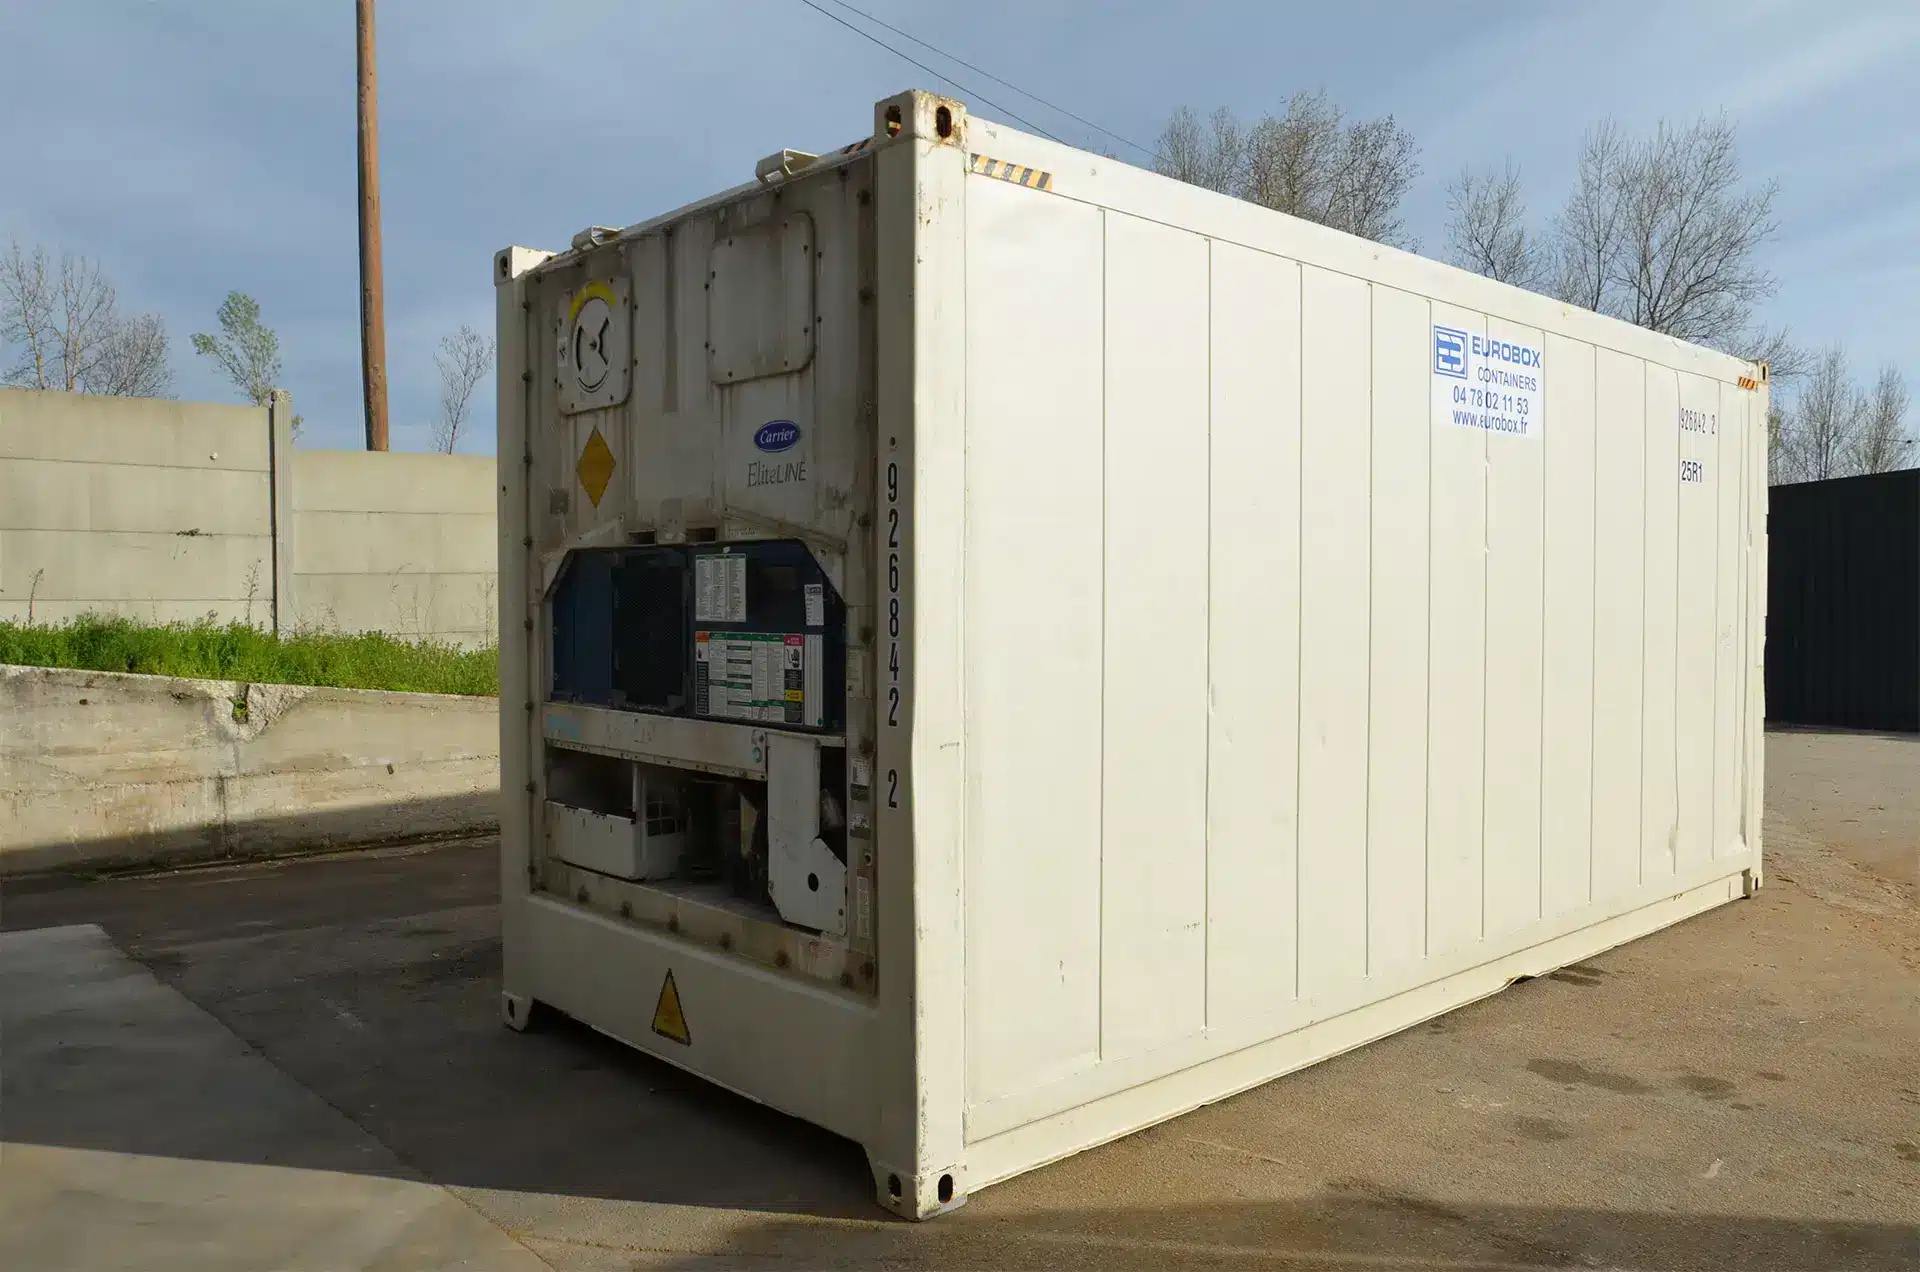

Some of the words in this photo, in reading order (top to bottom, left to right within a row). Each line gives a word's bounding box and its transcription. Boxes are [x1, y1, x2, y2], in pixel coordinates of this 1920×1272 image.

[1472, 336, 1540, 368] EUROBOX
[1478, 367, 1536, 391] CONTAINERS
[1453, 385, 1466, 404] 04
[1470, 389, 1483, 407] 78
[1486, 392, 1499, 409] 02
[1502, 395, 1513, 412] 11
[1517, 398, 1529, 415] 53
[1453, 410, 1528, 434] www.eurobox.fr
[1681, 408, 1706, 434] 926842
[1711, 414, 1716, 435] 2
[760, 428, 796, 444] Carrier
[747, 459, 807, 488] EliteLINE
[1681, 460, 1703, 483] 25R1
[888, 768, 898, 809] 2
